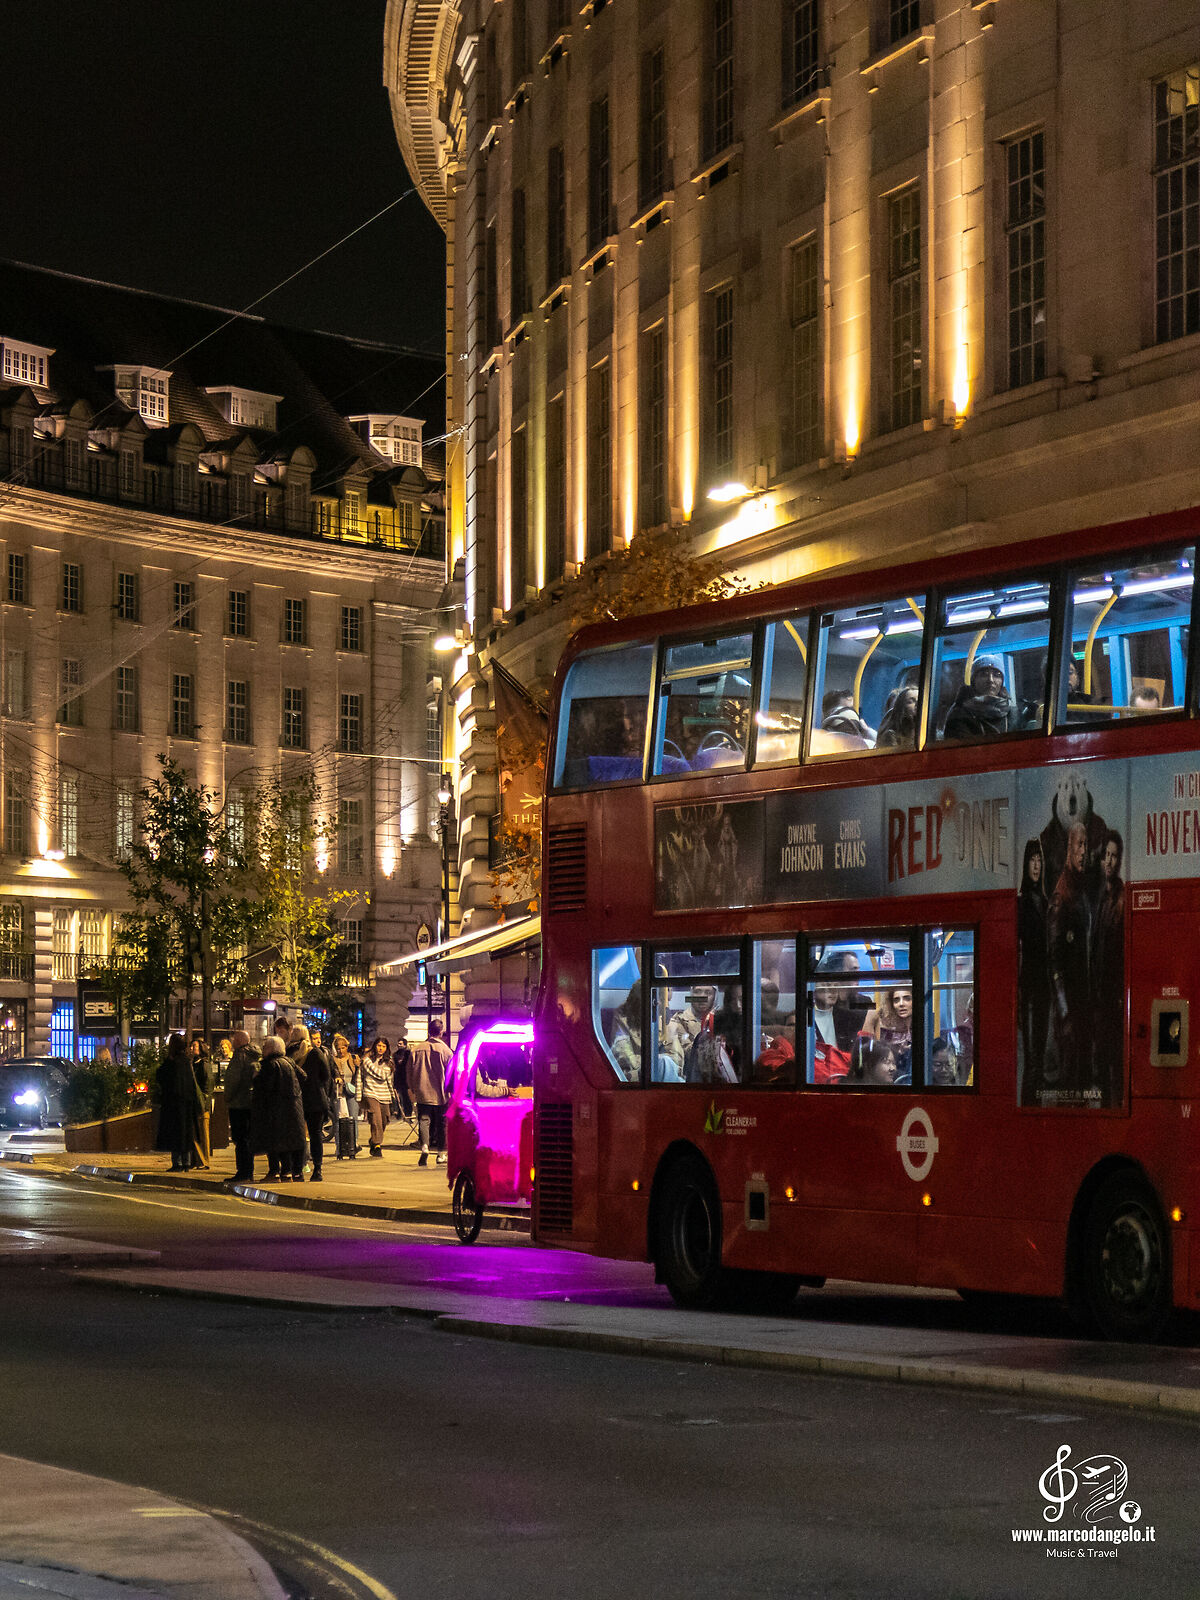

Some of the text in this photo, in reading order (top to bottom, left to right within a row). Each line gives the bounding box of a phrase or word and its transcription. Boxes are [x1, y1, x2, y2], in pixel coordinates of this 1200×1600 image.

[1174, 772, 1200, 799] IN CI
[787, 823, 817, 845] DWAYNE
[840, 819, 862, 841] CHRIS
[887, 797, 1010, 885] RED ONE
[780, 844, 824, 873] JOHNSON
[834, 840, 867, 870] EVANS
[908, 1139, 926, 1150] BUSES
